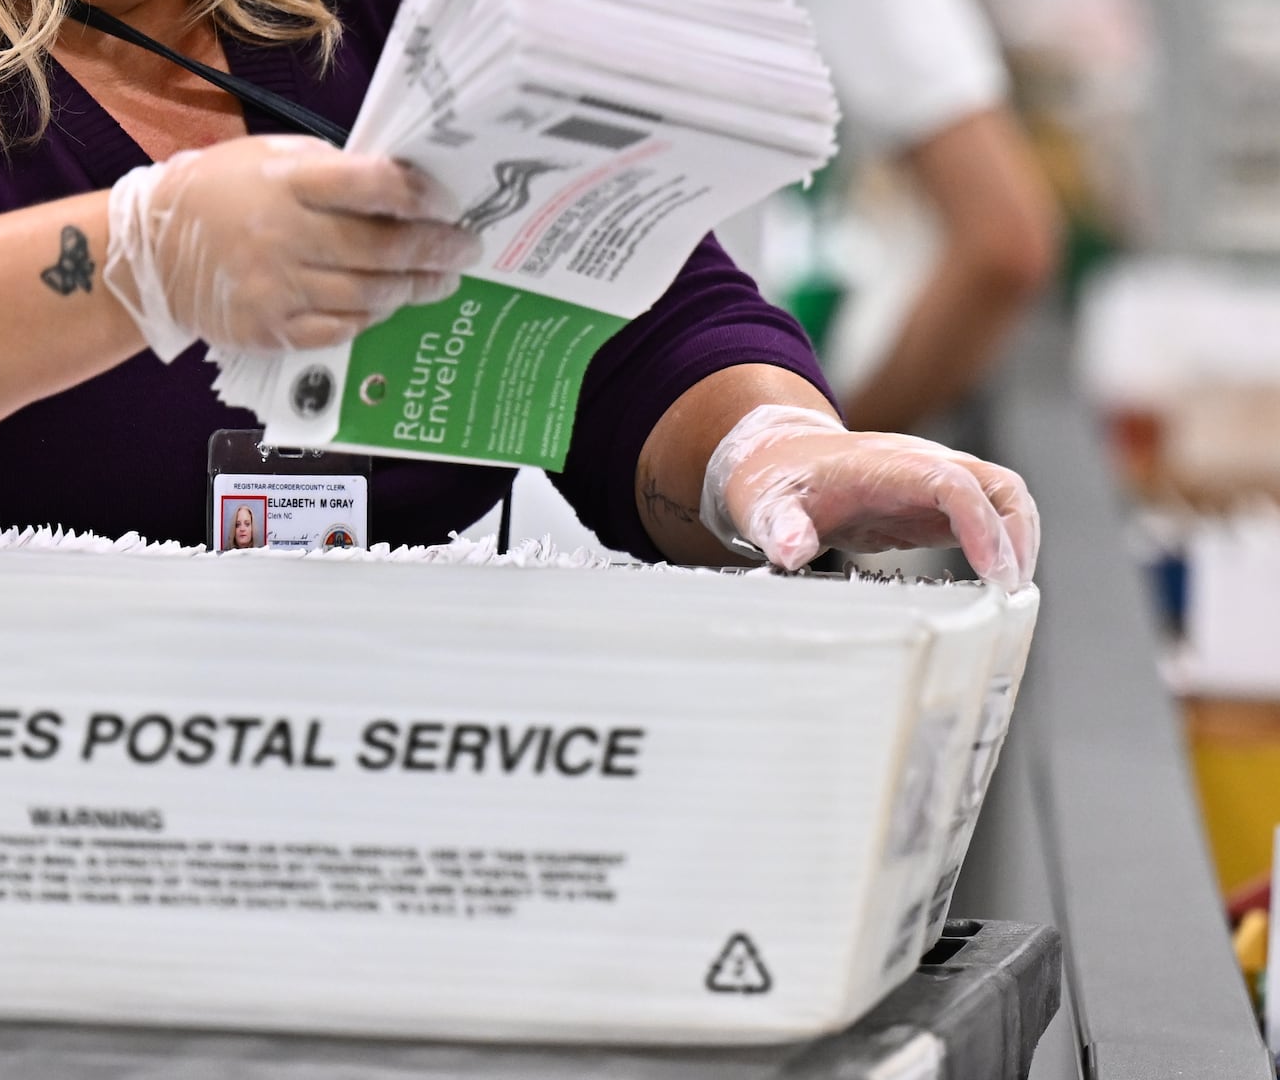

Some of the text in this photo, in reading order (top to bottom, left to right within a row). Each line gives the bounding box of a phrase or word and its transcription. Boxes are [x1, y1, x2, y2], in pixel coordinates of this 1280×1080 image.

[419, 298, 481, 445] Envelope
[394, 331, 440, 441] Return
[233, 482, 346, 491] REGISTRAR-RECORDER/COUNTY CLERK
[267, 497, 354, 508] ELIZABETH M GRAY
[267, 511, 293, 520] Clerk NC
[80, 709, 336, 770] POSTAL
[356, 718, 647, 778] SERVICE
[29, 806, 165, 834] WARNING
